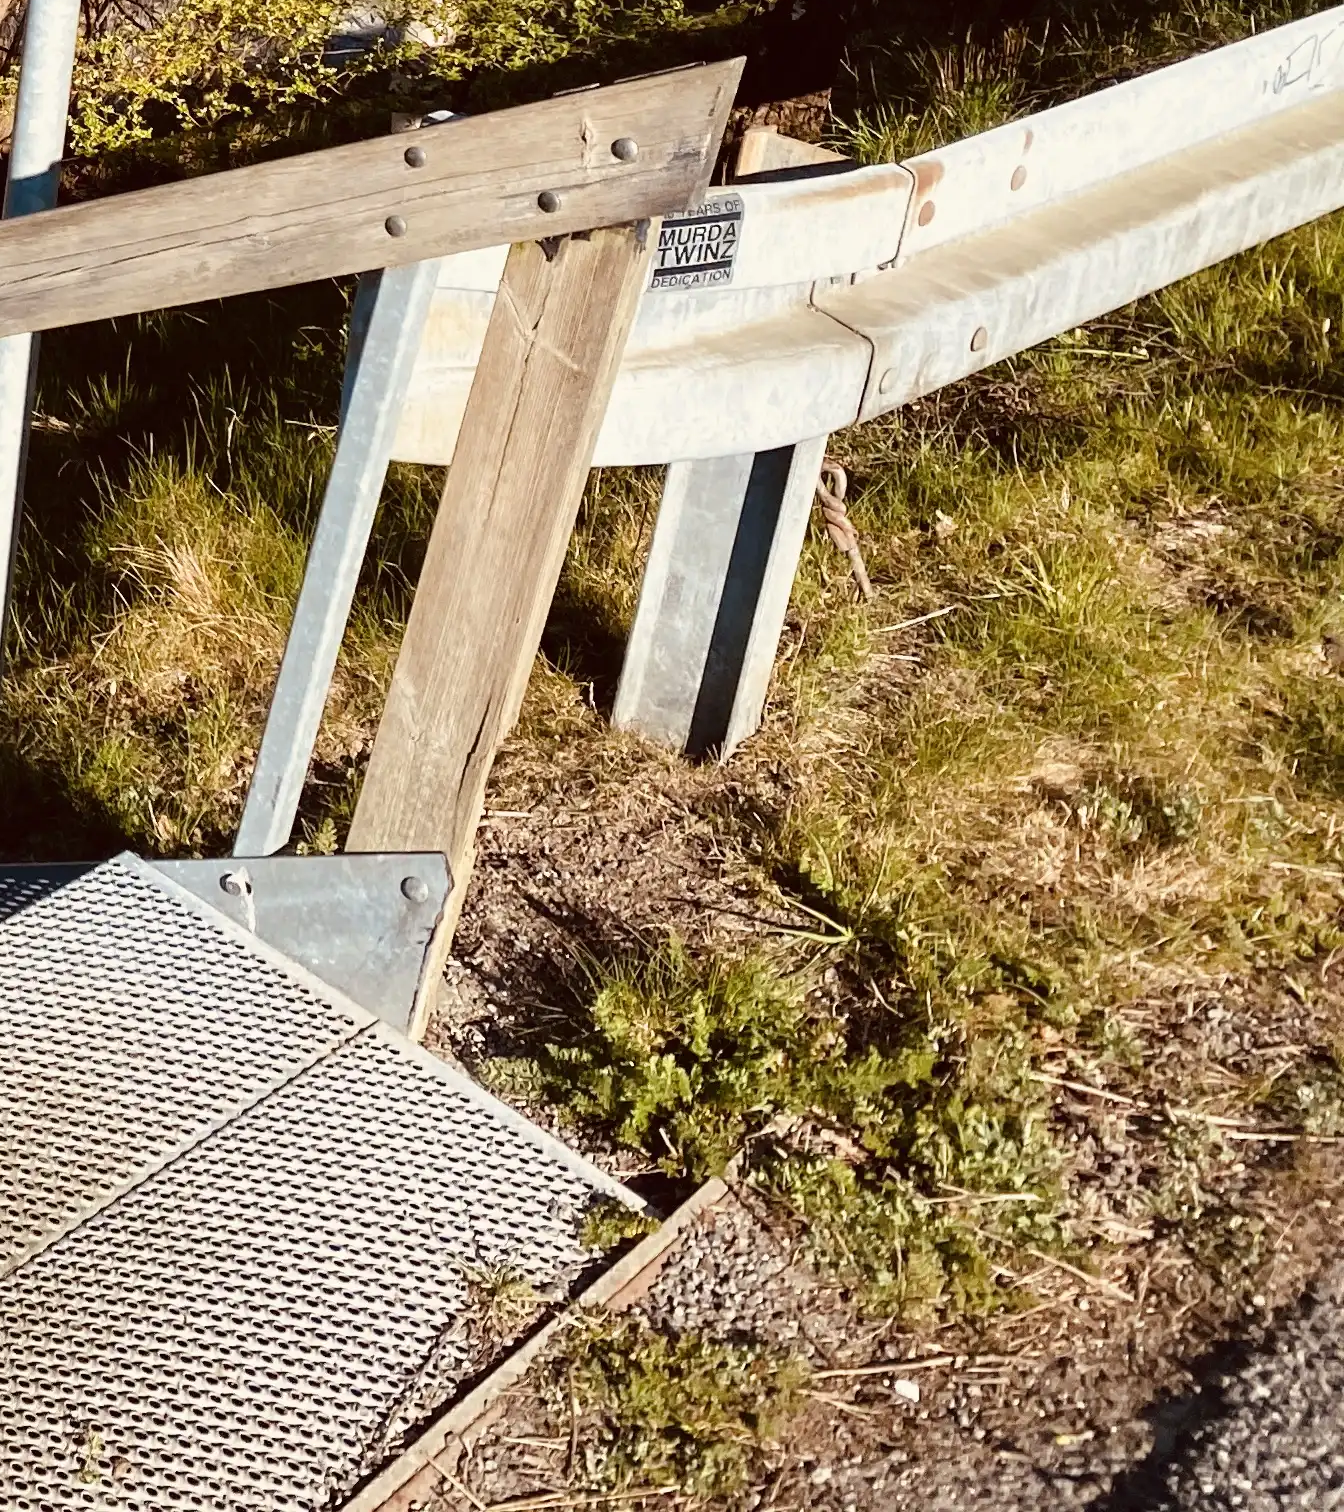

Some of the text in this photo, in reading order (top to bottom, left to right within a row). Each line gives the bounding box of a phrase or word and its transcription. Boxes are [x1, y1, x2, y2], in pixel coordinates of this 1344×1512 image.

[725, 200, 740, 212] OF
[659, 223, 736, 247] MURDA
[658, 240, 736, 267] TWINZ
[651, 269, 731, 289] DEDICATION
